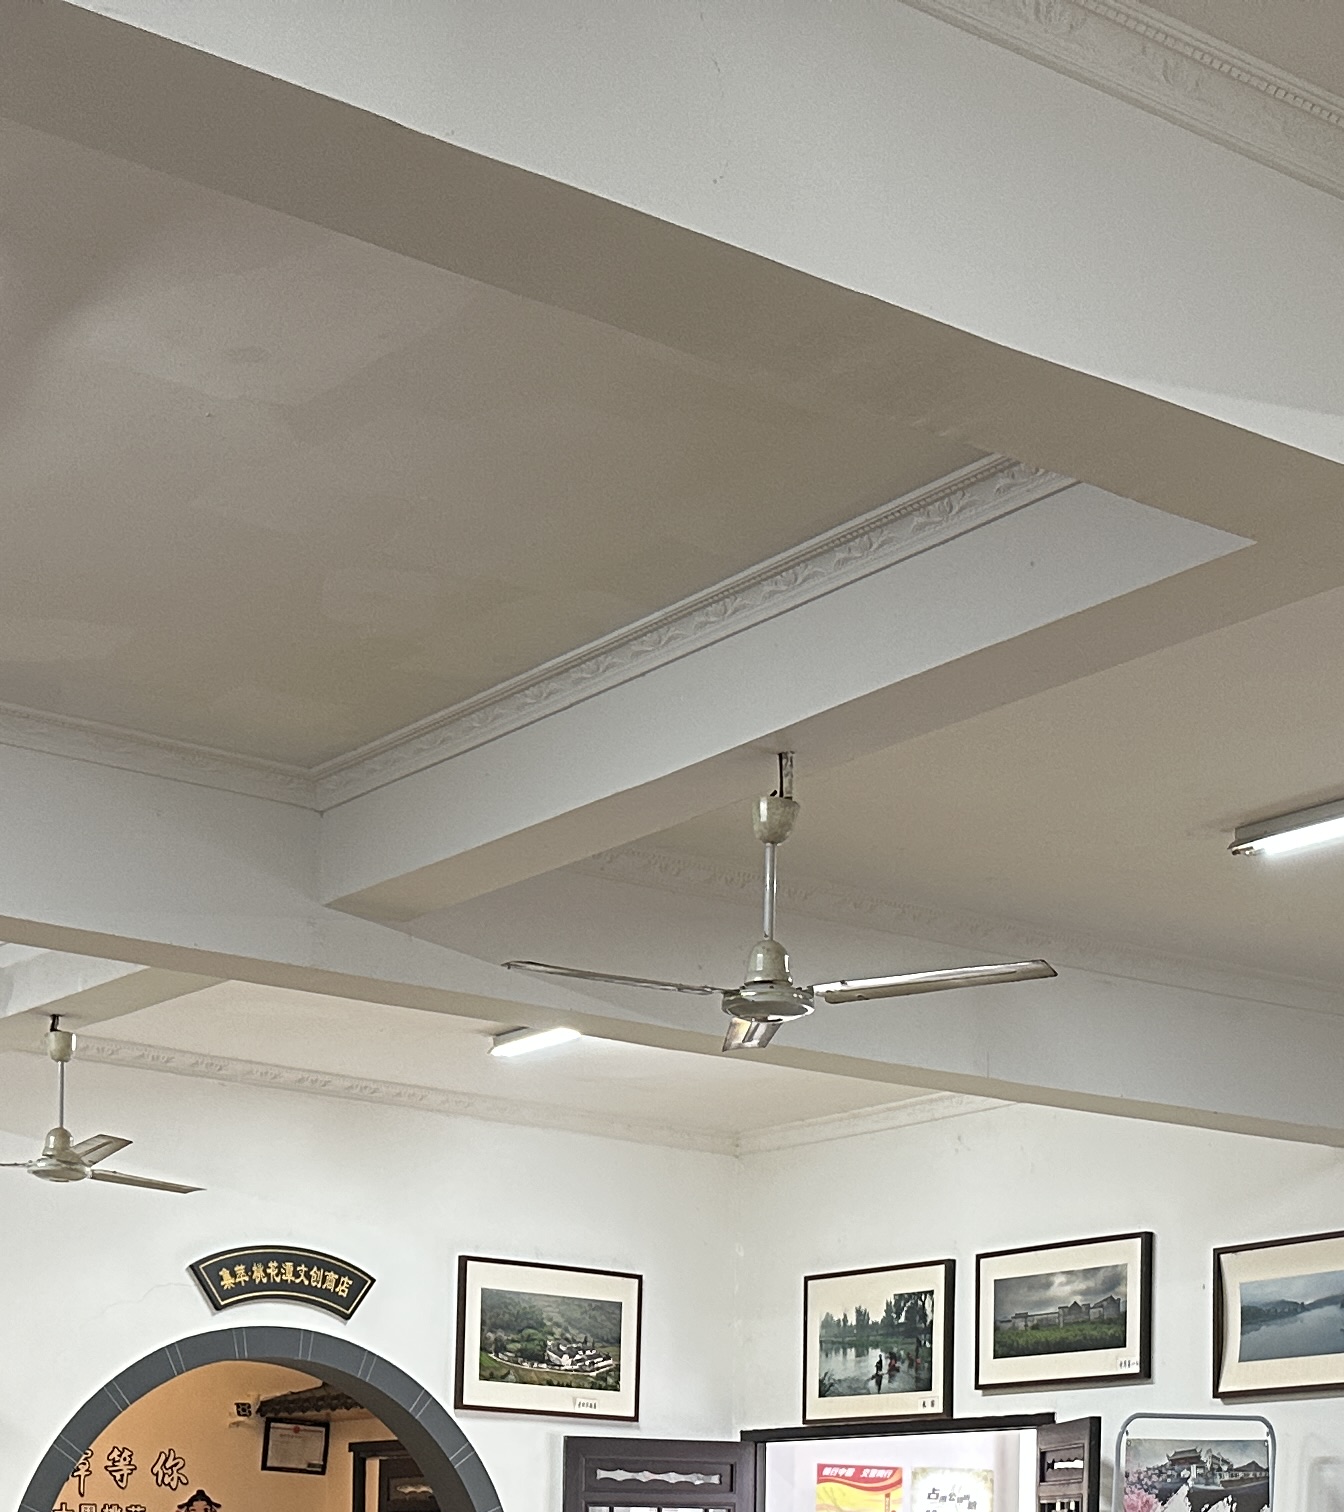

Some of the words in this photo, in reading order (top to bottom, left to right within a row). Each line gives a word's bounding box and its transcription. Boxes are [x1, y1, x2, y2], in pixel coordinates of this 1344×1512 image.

[218, 1260, 354, 1298] 集萃·桃花潭文创商店
